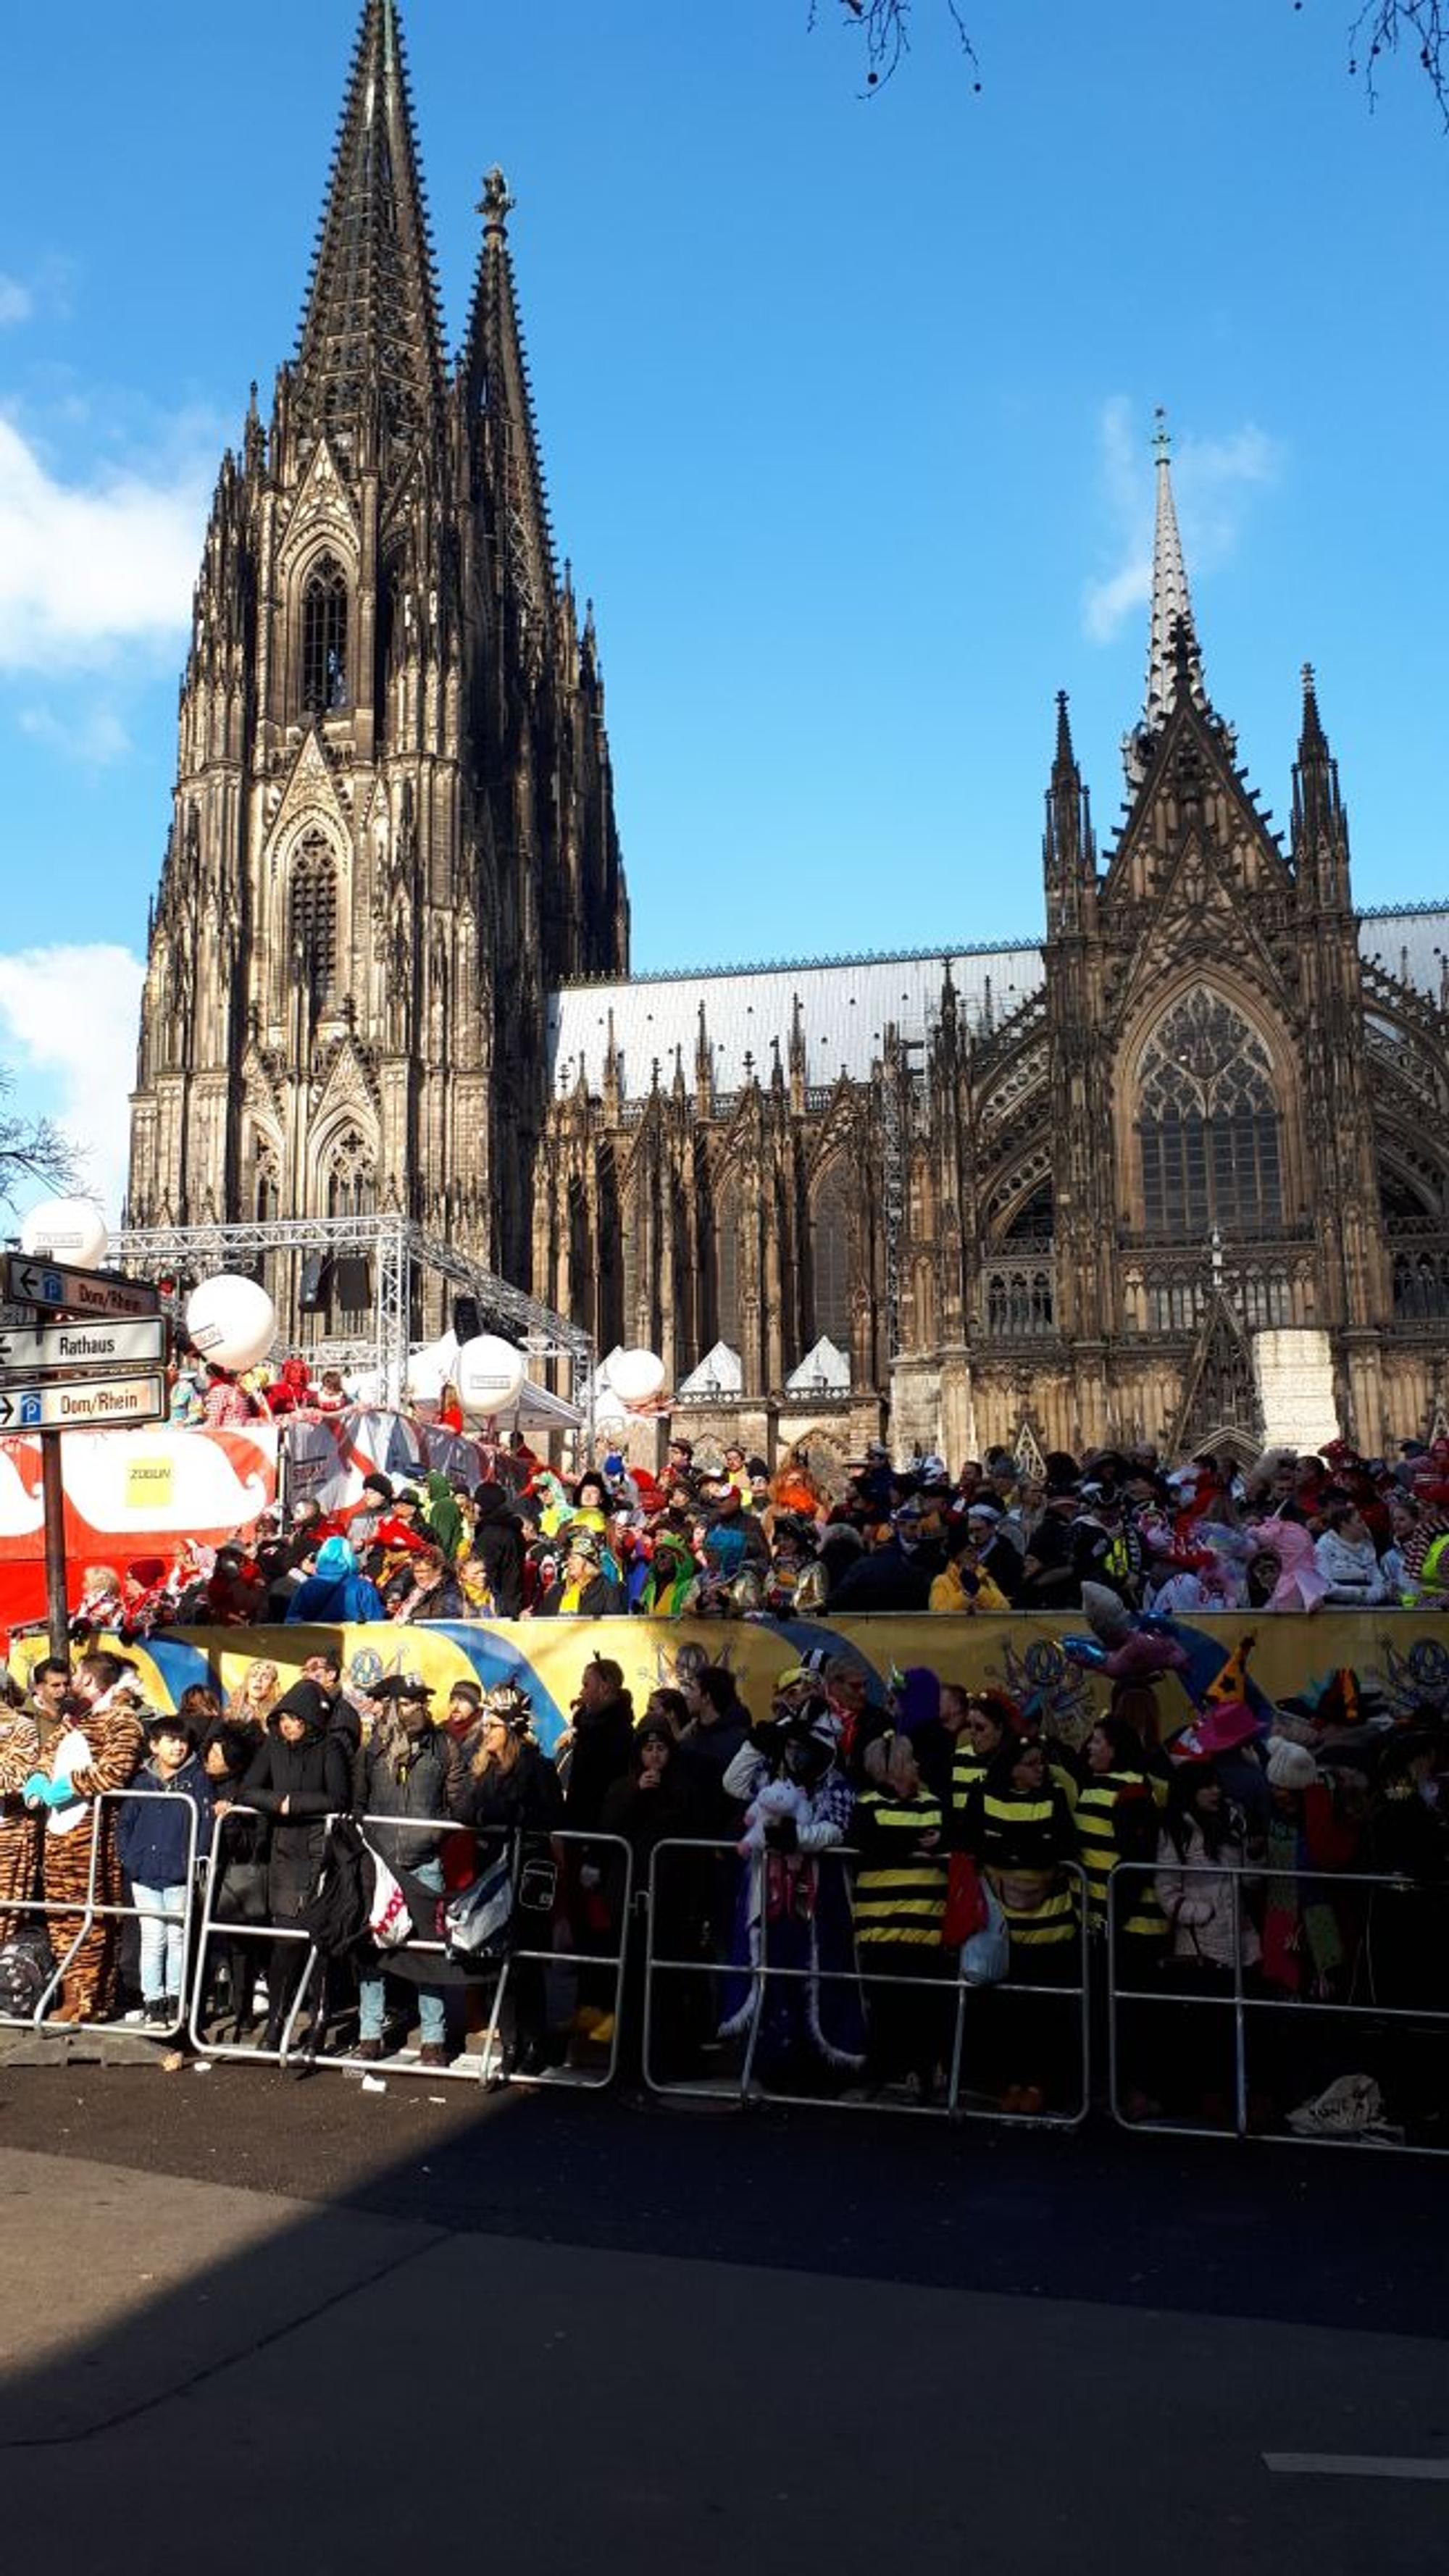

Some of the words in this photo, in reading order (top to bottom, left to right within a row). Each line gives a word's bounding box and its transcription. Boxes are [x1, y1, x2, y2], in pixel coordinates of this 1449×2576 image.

[78, 1283, 142, 1313] Dom/Rhein
[59, 1335, 115, 1355] Rathaus
[61, 1389, 138, 1415] Dom/Rhein
